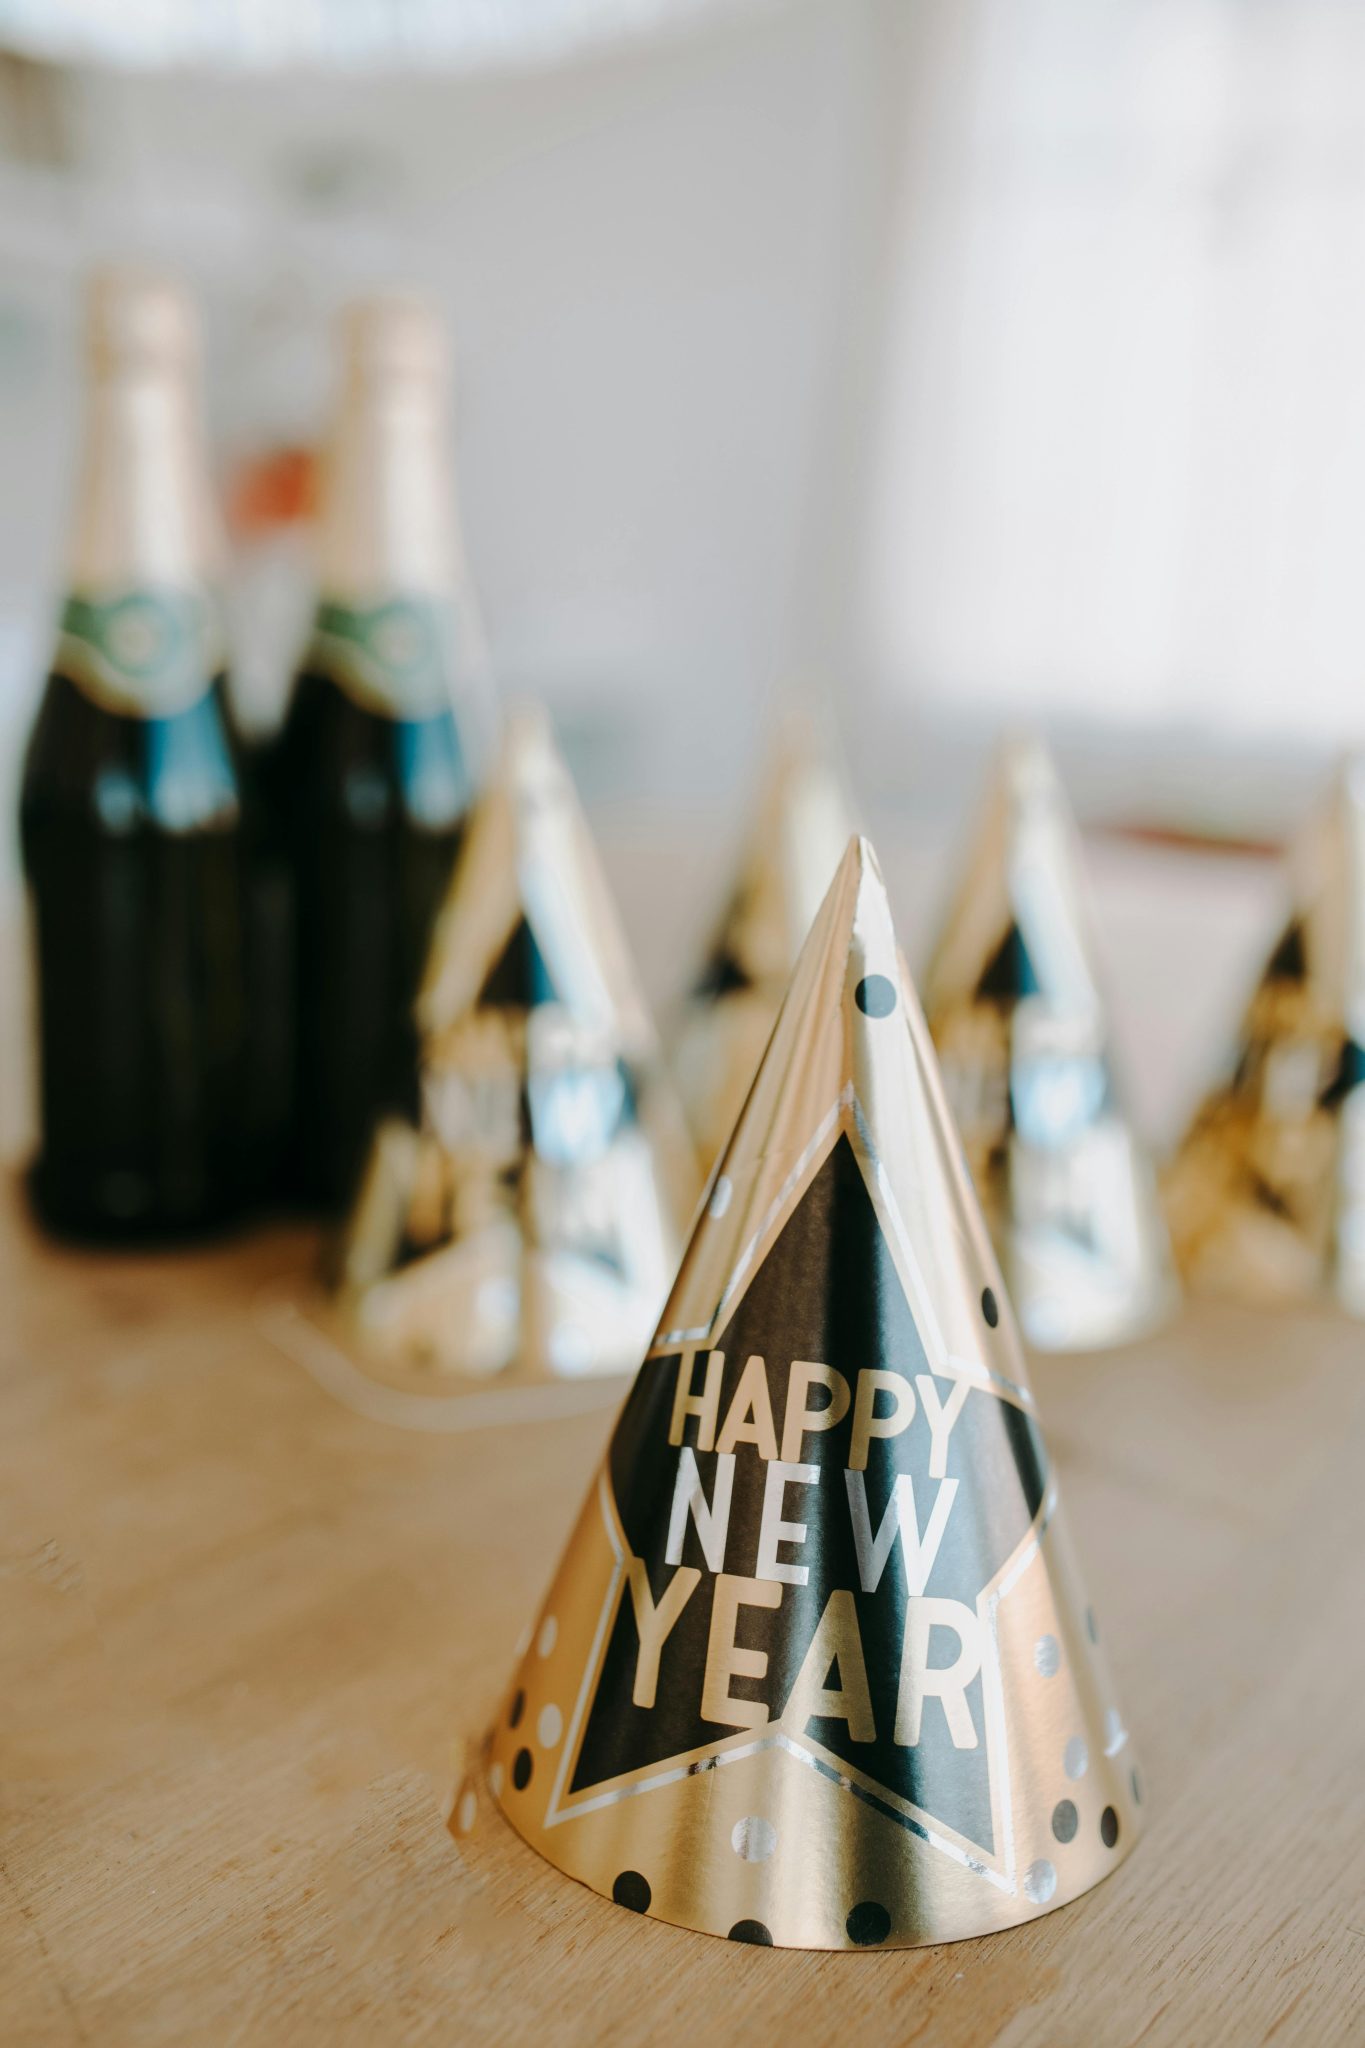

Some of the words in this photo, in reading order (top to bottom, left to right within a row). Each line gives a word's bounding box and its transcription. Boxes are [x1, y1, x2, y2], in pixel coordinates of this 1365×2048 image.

[668, 1349, 971, 1479] HAPPY
[665, 1447, 960, 1597] NEW
[628, 1556, 983, 1749] YEAR
